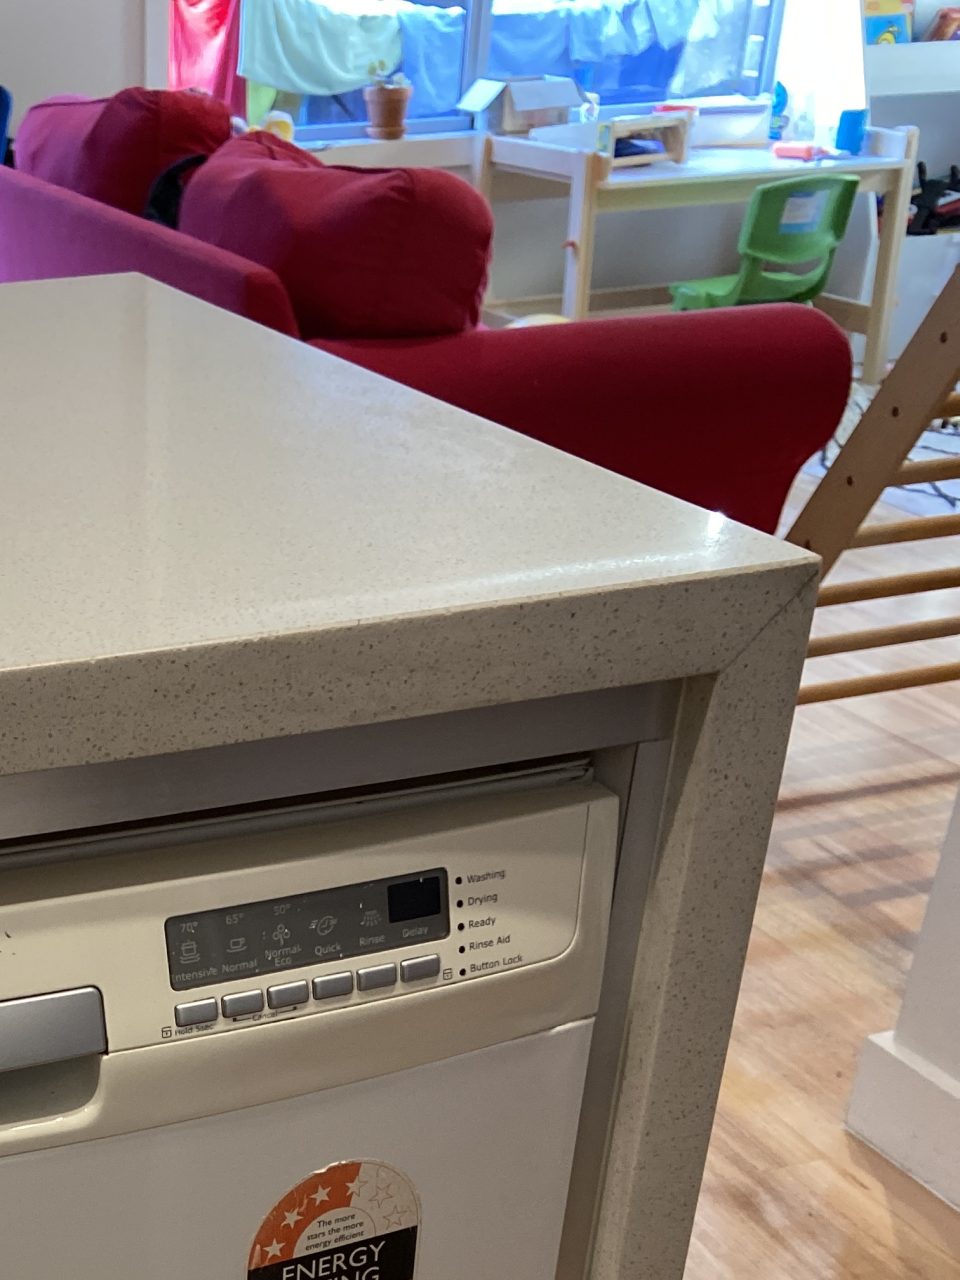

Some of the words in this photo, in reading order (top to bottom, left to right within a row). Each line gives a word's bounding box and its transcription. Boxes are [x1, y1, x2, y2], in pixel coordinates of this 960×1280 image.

[466, 868, 507, 884] Washing
[467, 893, 499, 907] Drying
[468, 916, 496, 930] Ready
[402, 926, 429, 938] Delay
[359, 934, 386, 947] Rinse
[468, 939, 495, 951] Rinse
[496, 934, 512, 945] Aid
[264, 945, 302, 961] Normal
[314, 942, 342, 957] Quick
[221, 958, 258, 973] Normal
[469, 959, 500, 973] Button
[502, 954, 524, 966] Lock
[171, 967, 219, 983] Intensive
[316, 1217, 332, 1229] The
[334, 1213, 356, 1225] more
[307, 1230, 326, 1242] stars
[328, 1226, 341, 1237] the
[342, 1220, 364, 1232] more
[305, 1238, 332, 1251] energy
[334, 1230, 365, 1243] efficient
